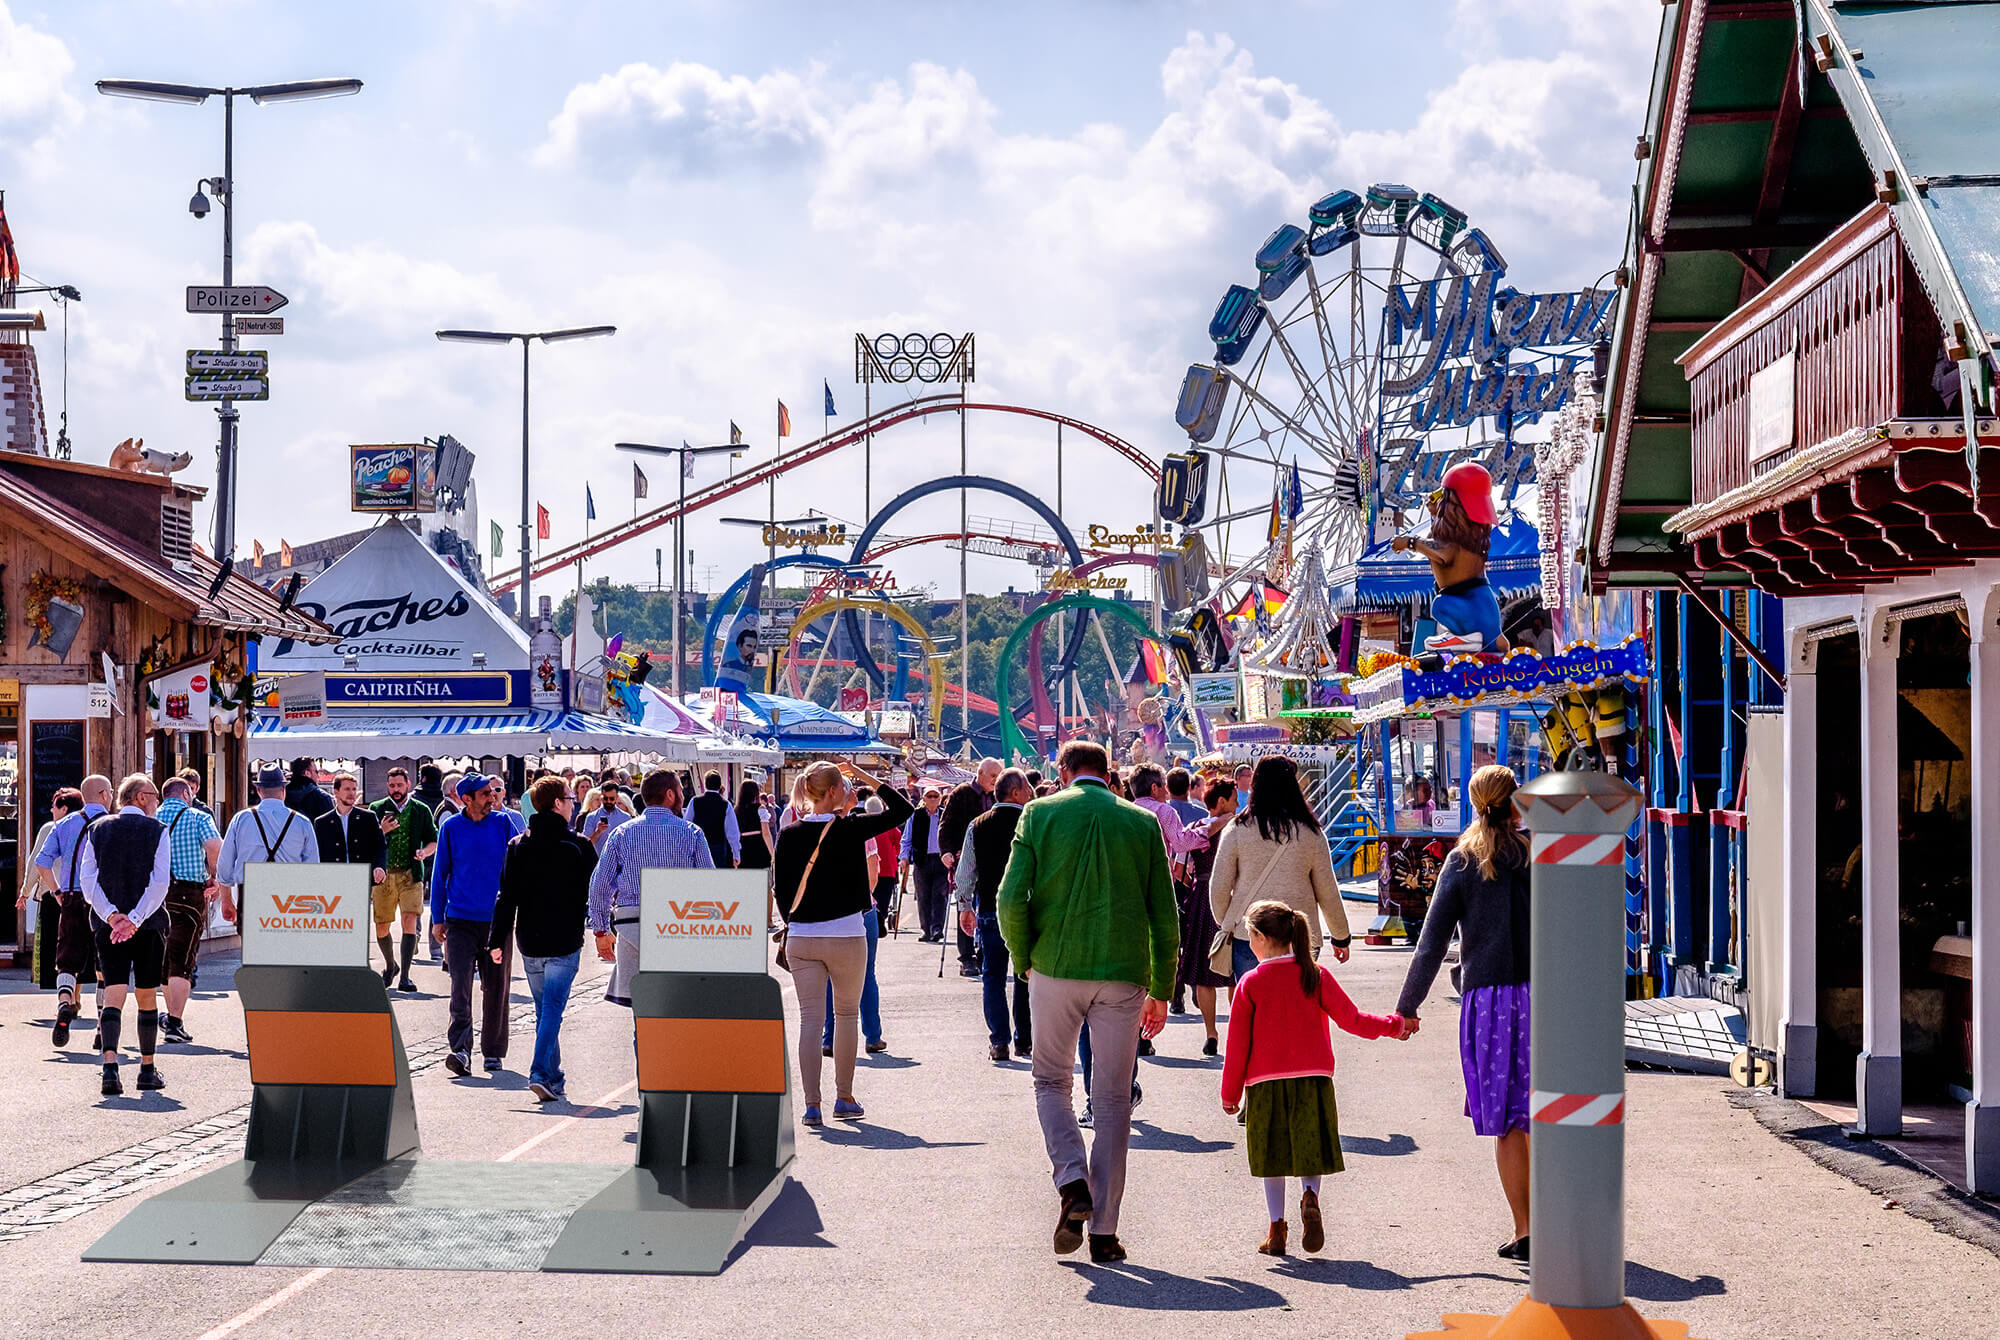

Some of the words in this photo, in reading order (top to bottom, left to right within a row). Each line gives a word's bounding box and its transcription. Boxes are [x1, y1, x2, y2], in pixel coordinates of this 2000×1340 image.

[196, 290, 257, 306] Polizei
[238, 321, 244, 330] 12
[247, 321, 281, 330] Notruf-SOS
[212, 358, 238, 367] Straße
[211, 383, 236, 392] Straße
[353, 447, 415, 483] Peaches
[762, 524, 846, 549] Olympia
[1088, 524, 1173, 548] Looping
[1043, 568, 1128, 589] München
[760, 600, 786, 608] Polizei
[333, 641, 461, 656] Cocktailbar
[1463, 656, 1614, 688] Kroko-Angeln
[344, 680, 453, 696] CAIPIRIÑHA
[90, 698, 108, 708] 512
[284, 711, 322, 719] FRITES
[271, 894, 343, 915] VSV
[668, 900, 741, 921] VSV
[258, 916, 354, 930] VOLKMANN
[655, 923, 753, 937] VOLKMANN
